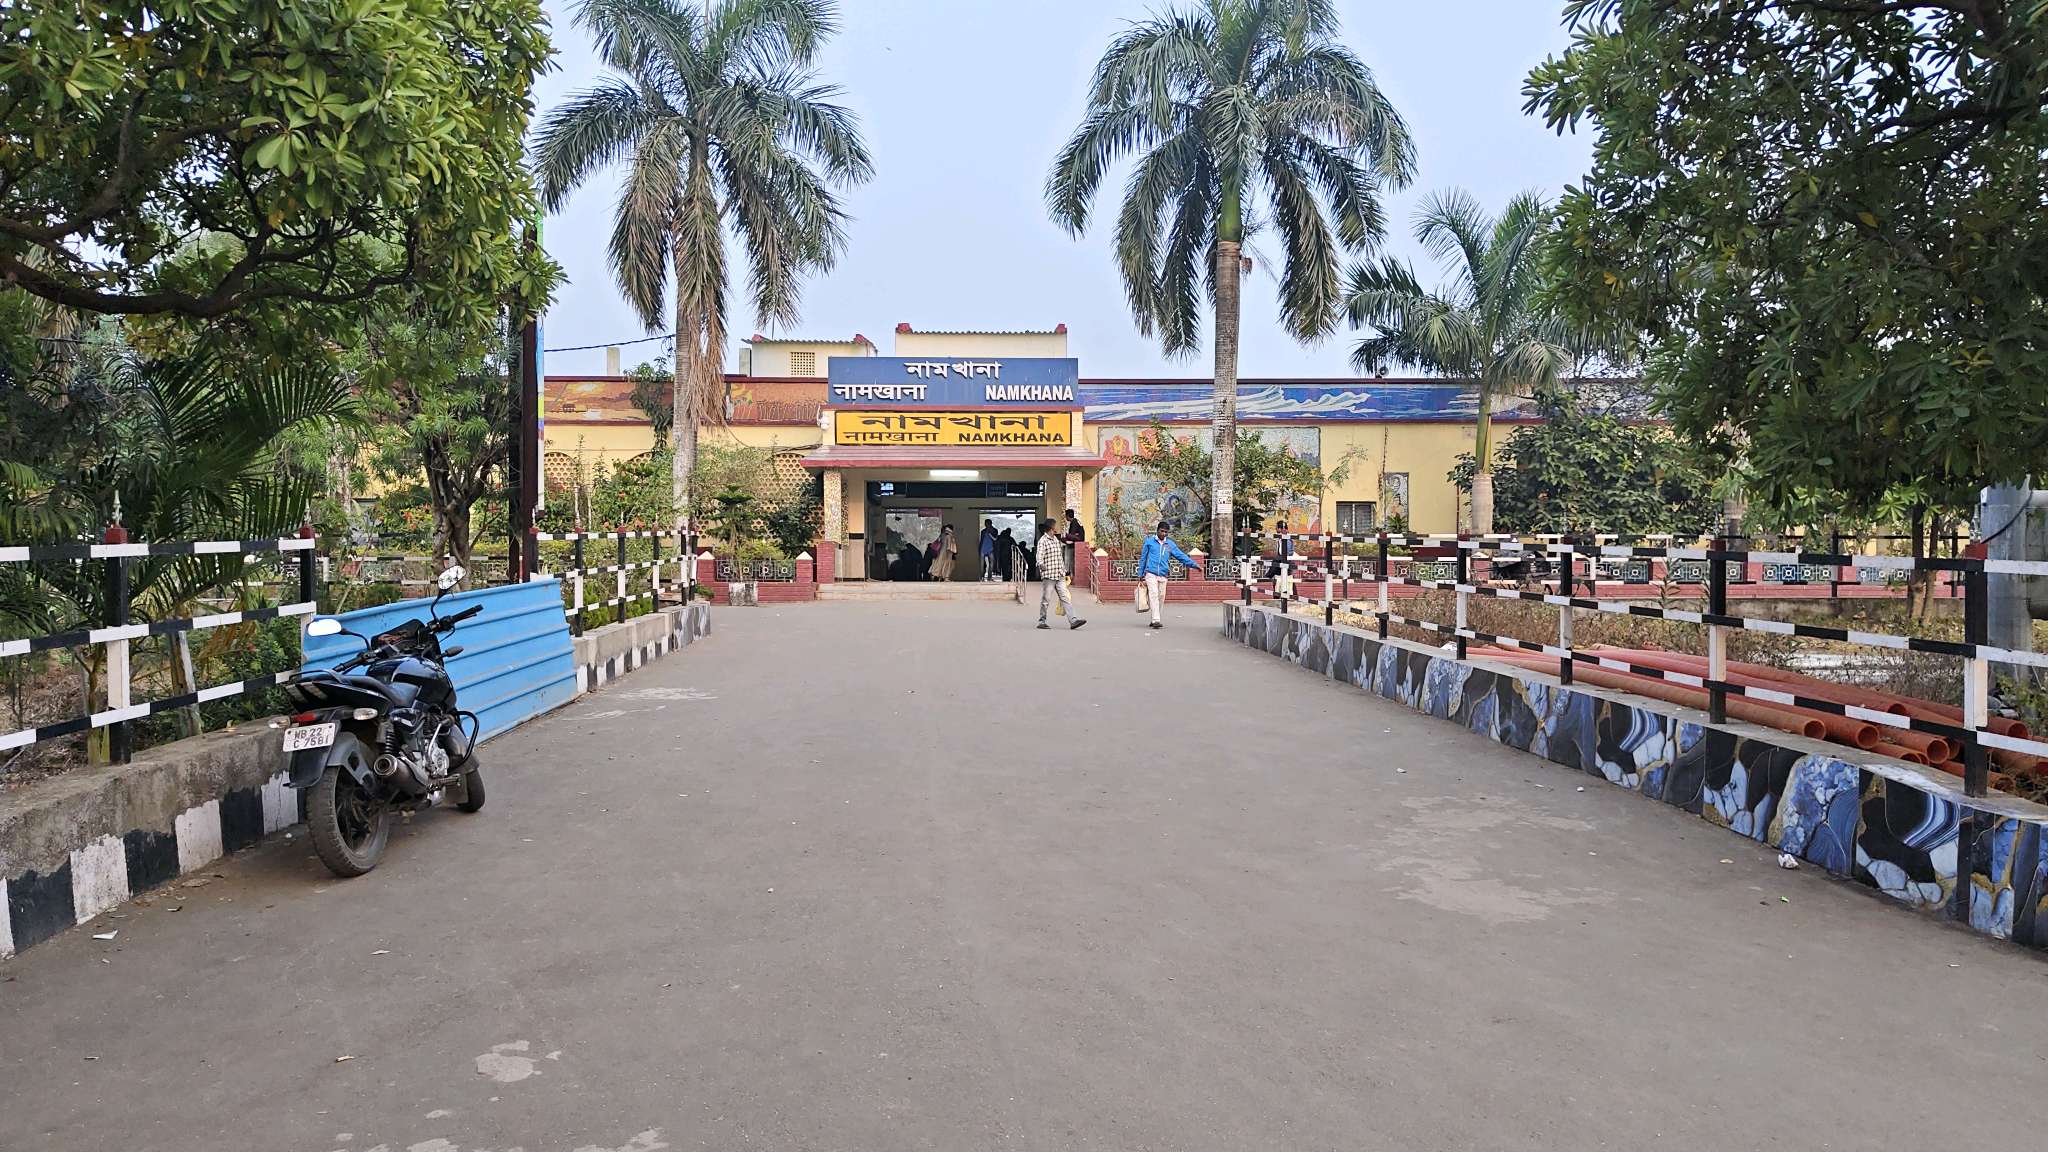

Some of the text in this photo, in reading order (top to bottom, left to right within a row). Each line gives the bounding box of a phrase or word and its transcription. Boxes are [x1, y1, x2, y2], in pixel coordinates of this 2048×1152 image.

[832, 384, 927, 401] नामखाना
[985, 384, 1074, 401] NAMKHANA
[843, 432, 939, 442] नामखाना
[958, 432, 1065, 443] NAMKHANA
[309, 727, 322, 737] 22
